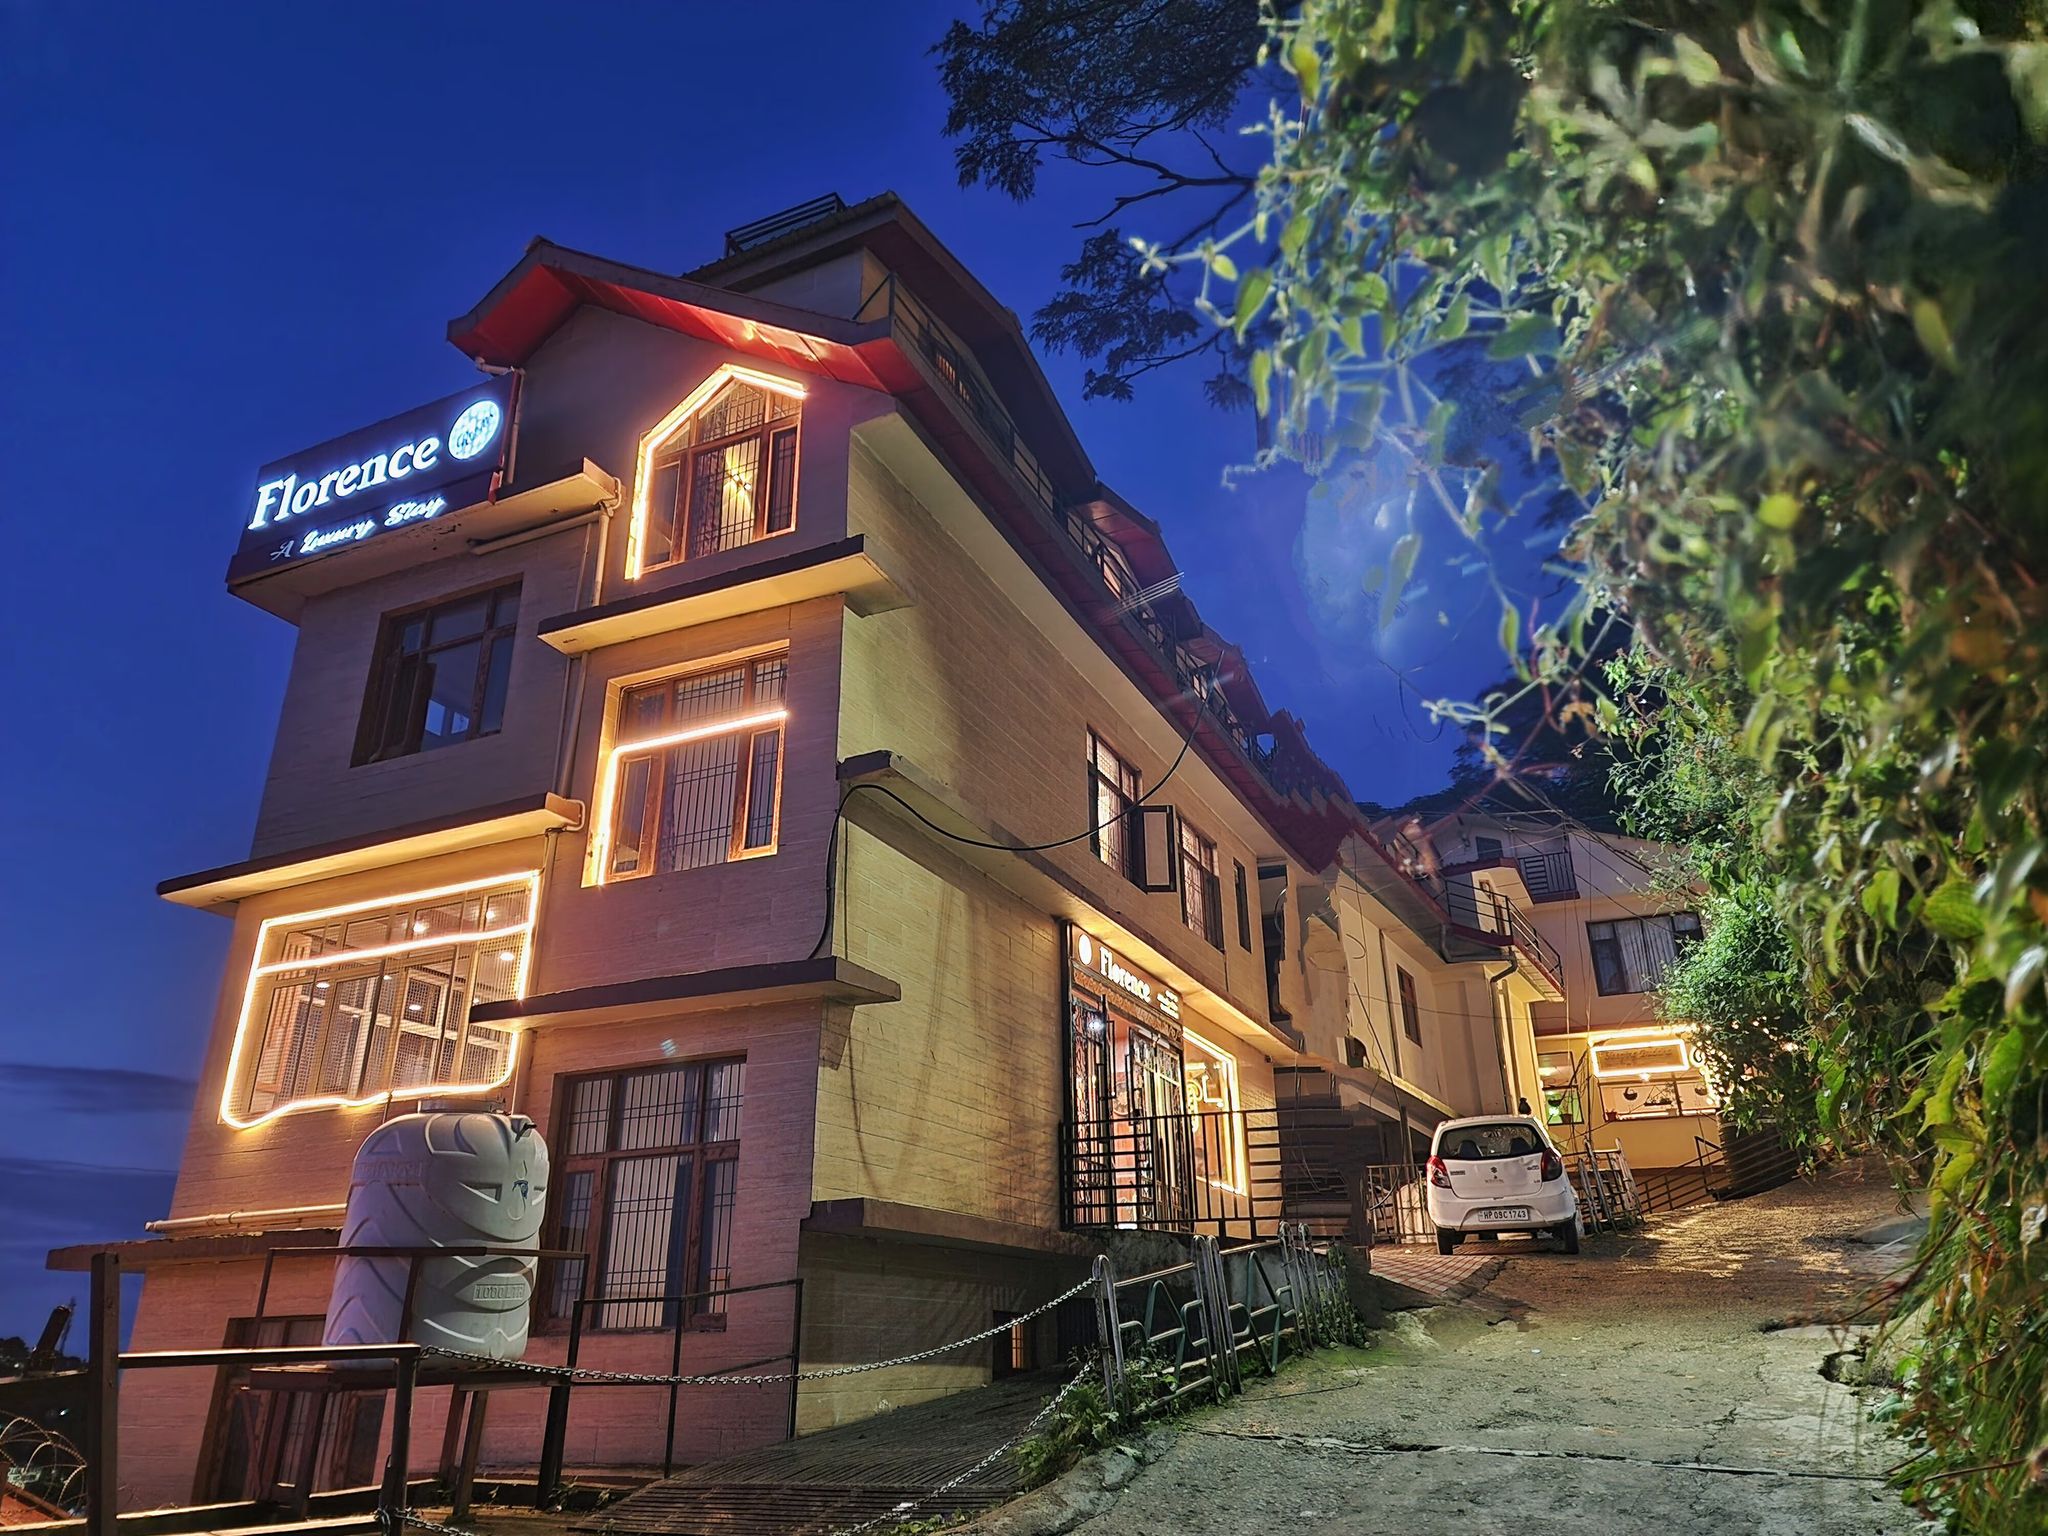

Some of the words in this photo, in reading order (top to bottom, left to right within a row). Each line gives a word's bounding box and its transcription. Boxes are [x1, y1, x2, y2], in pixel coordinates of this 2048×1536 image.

[248, 437, 440, 530] Florence
[270, 540, 292, 560] A
[385, 496, 448, 527] Stay
[1100, 946, 1151, 1004] Florence
